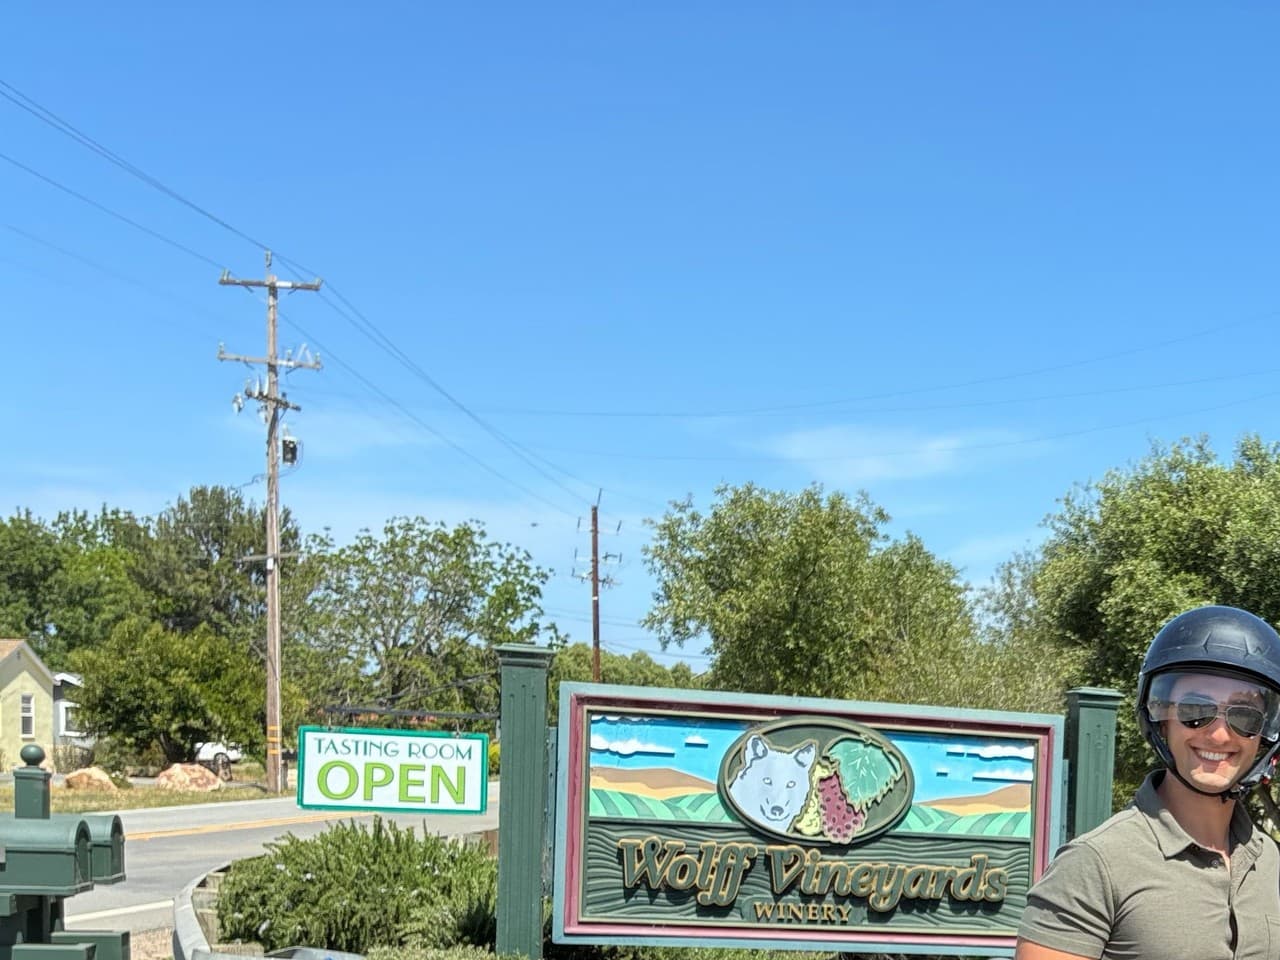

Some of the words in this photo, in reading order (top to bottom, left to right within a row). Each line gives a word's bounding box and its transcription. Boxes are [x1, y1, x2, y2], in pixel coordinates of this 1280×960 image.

[314, 738, 399, 758] TASTING
[408, 742, 472, 760] ROOM
[317, 760, 466, 804] OPEN
[618, 836, 758, 906] Wolff
[766, 845, 1008, 913] Vineyards
[753, 902, 852, 922] WINERY
